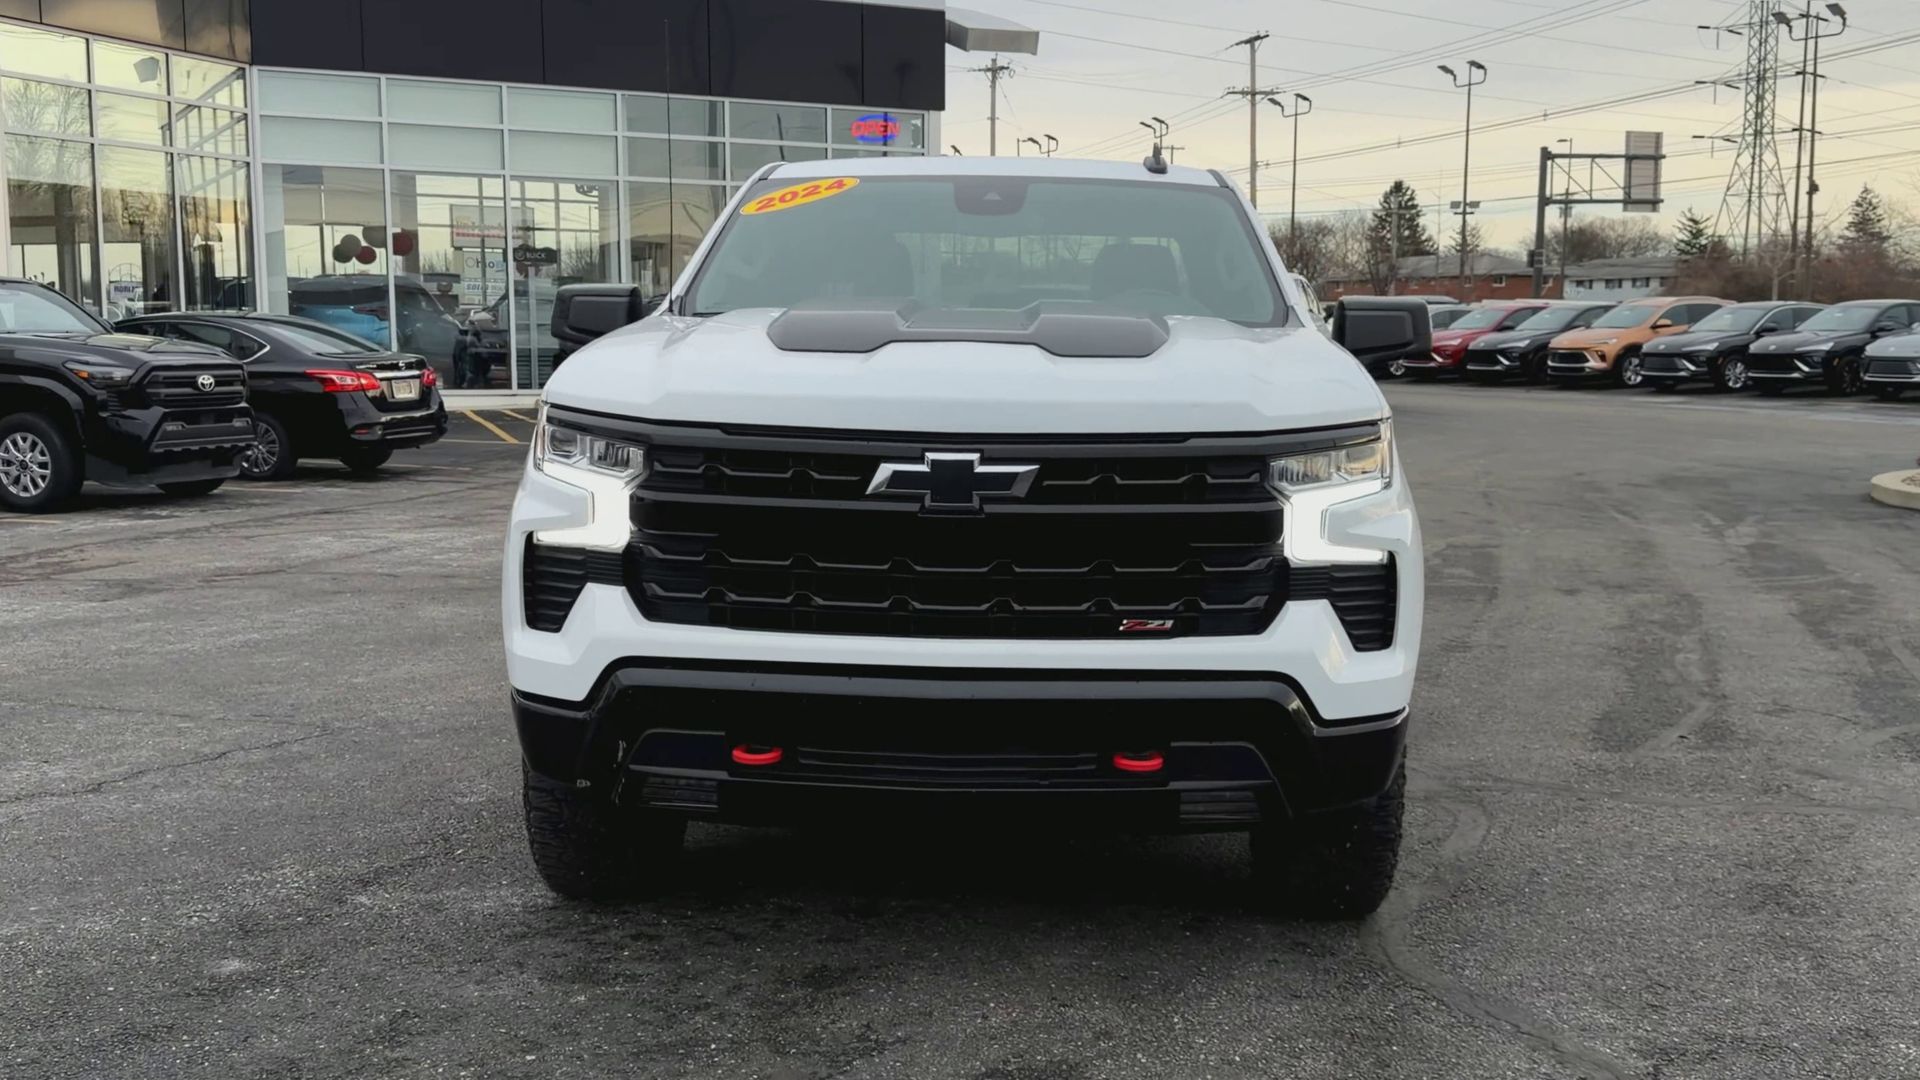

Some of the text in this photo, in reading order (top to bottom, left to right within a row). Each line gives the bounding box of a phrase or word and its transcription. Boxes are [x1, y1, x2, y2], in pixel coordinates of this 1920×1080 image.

[851, 120, 901, 137] OPEN
[755, 178, 847, 212] 2024
[465, 256, 495, 269] Oho
[1118, 619, 1175, 631] Z71
